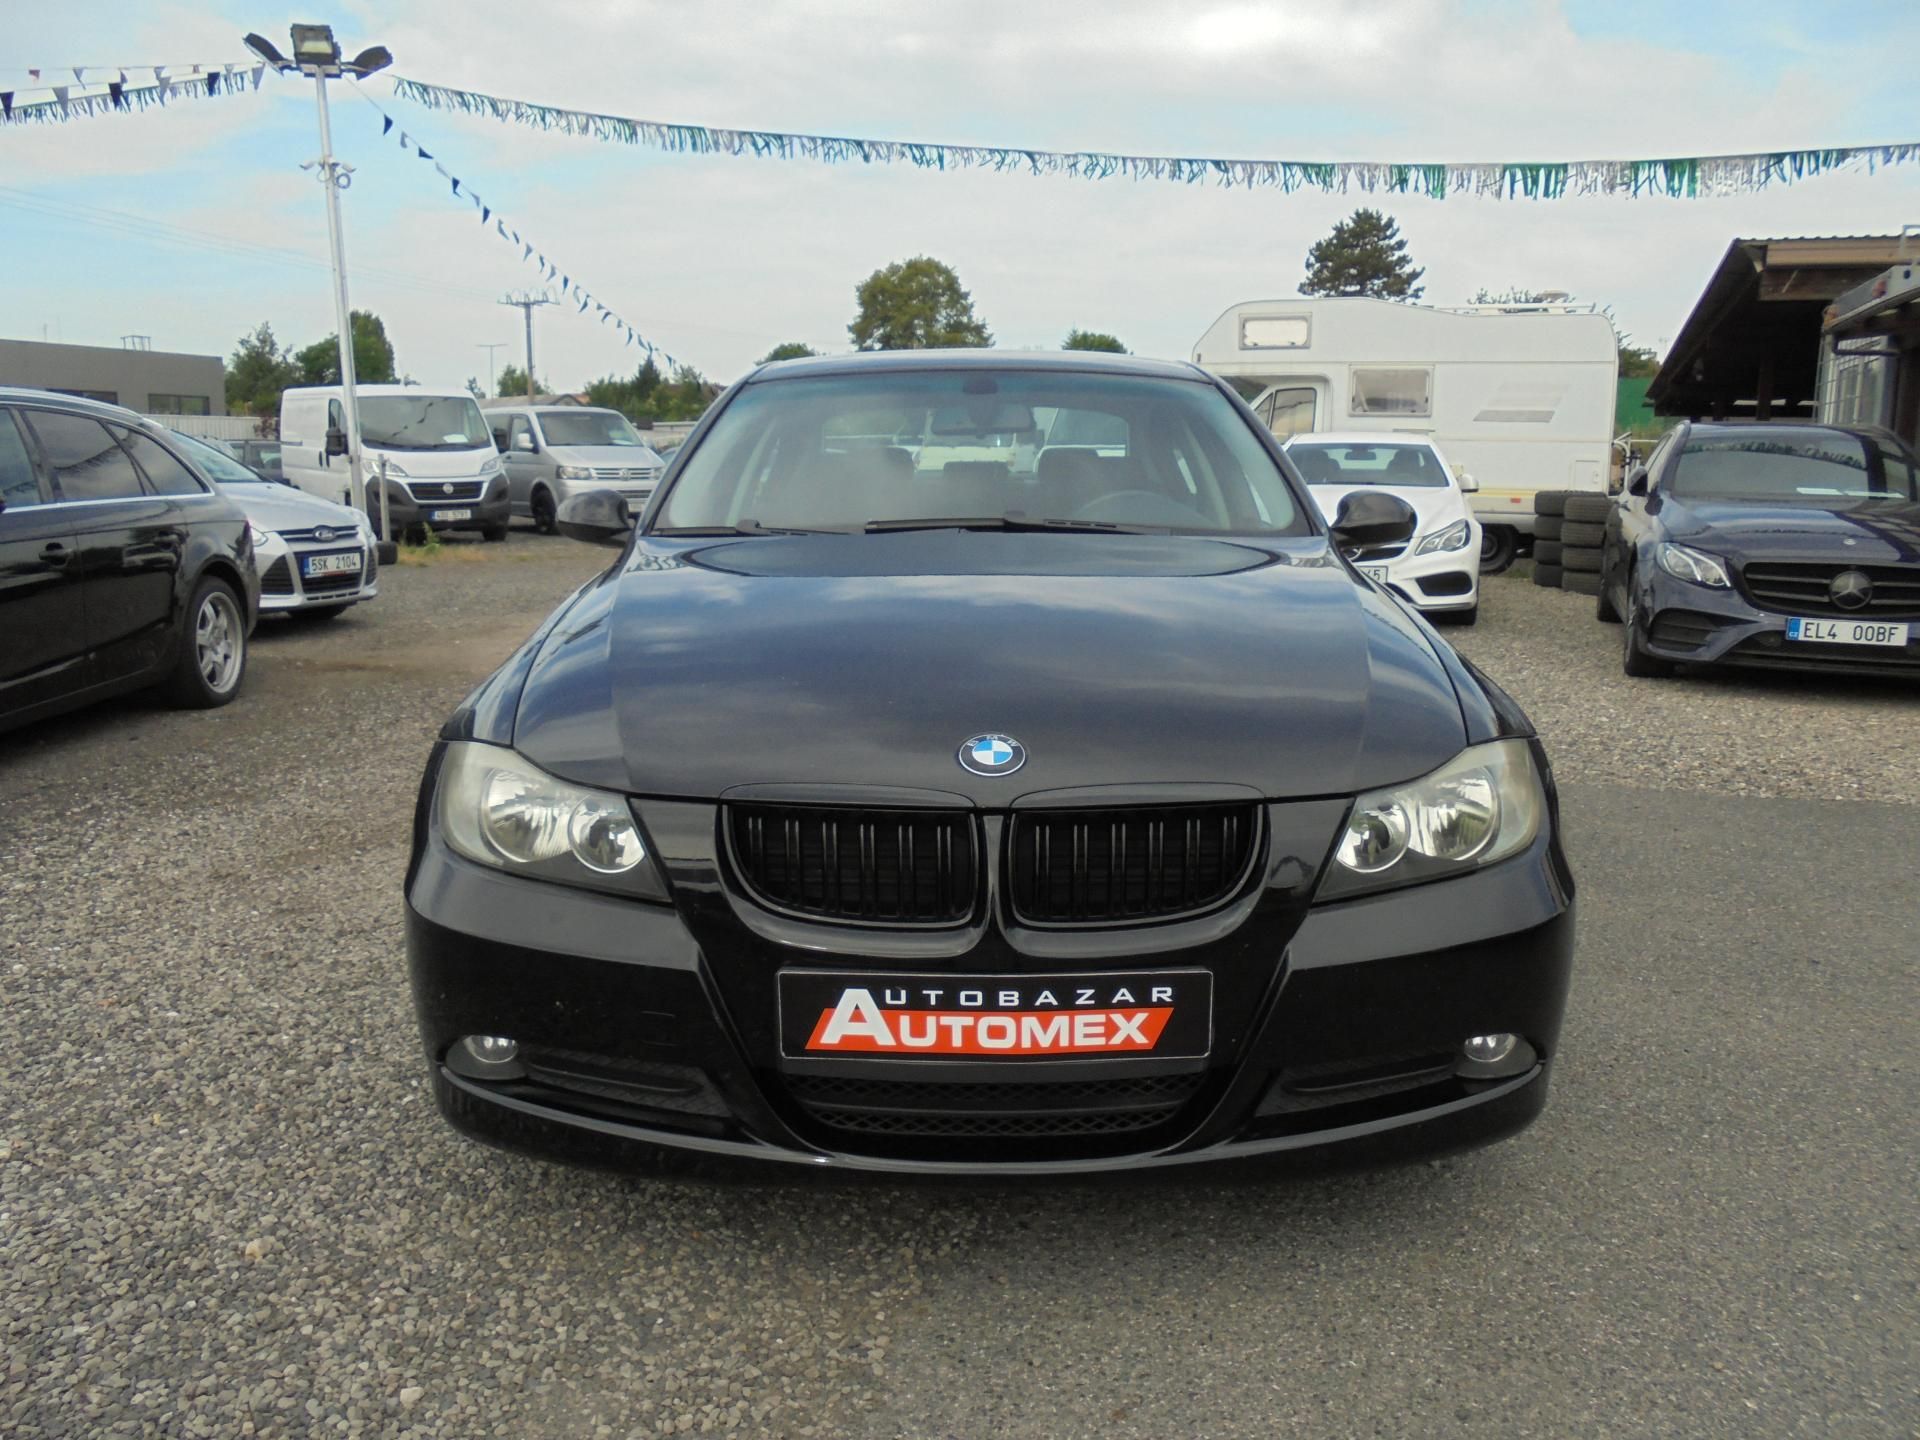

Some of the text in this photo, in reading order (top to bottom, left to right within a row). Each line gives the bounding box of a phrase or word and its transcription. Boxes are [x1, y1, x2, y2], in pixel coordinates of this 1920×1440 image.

[311, 555, 357, 571] 5SK 2104
[1804, 622, 1838, 640] EL4
[819, 988, 1149, 1049] AUTOMEX
